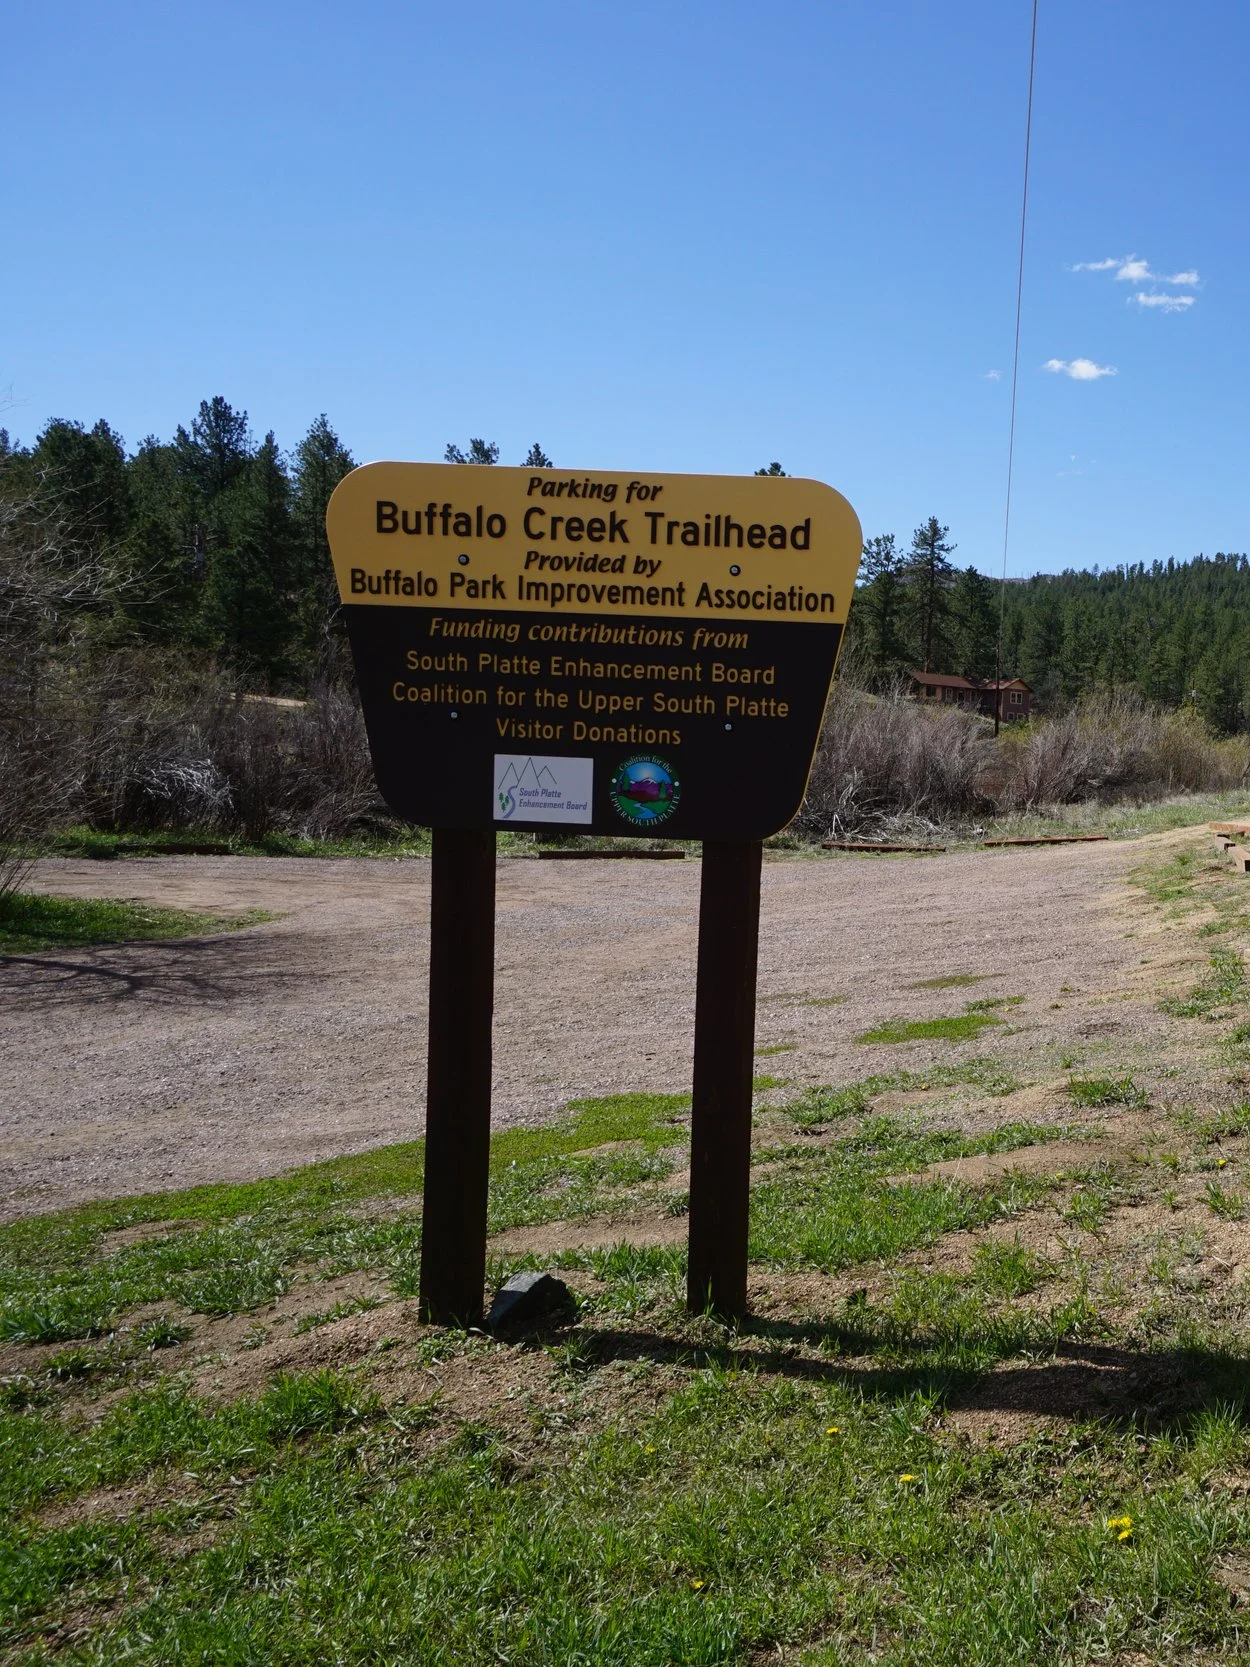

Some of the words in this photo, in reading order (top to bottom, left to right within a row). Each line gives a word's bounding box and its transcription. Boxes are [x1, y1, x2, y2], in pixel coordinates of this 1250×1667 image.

[527, 477, 618, 503] Parking
[625, 481, 663, 503] for
[376, 501, 506, 538] Buffalo
[524, 507, 630, 543] Creek
[644, 512, 811, 550] Trailhead
[524, 551, 625, 574] Provided
[633, 557, 661, 578] by
[351, 568, 438, 597] Buffalo
[451, 572, 506, 600] Park
[518, 575, 685, 607] Improvement
[696, 582, 834, 613] Association
[429, 617, 520, 643] Funding
[528, 622, 683, 647] contributions
[693, 628, 749, 650] from
[407, 651, 469, 672] South
[478, 654, 541, 675] Platte
[551, 657, 702, 681] Enhancement
[712, 664, 775, 685] Board
[393, 682, 487, 705] Coalition
[497, 685, 528, 706] for
[535, 688, 568, 708] the
[578, 690, 644, 715] Upper
[653, 693, 715, 714] South
[725, 697, 789, 718] Platte
[496, 718, 563, 740] Visitor
[574, 722, 680, 745] Donations
[619, 755, 650, 770] Coalition
[652, 756, 662, 765] for
[662, 763, 672, 773] the
[519, 788, 539, 797] South
[541, 789, 561, 798] Platte
[519, 800, 564, 810] Enhancement
[567, 801, 587, 810] Board
